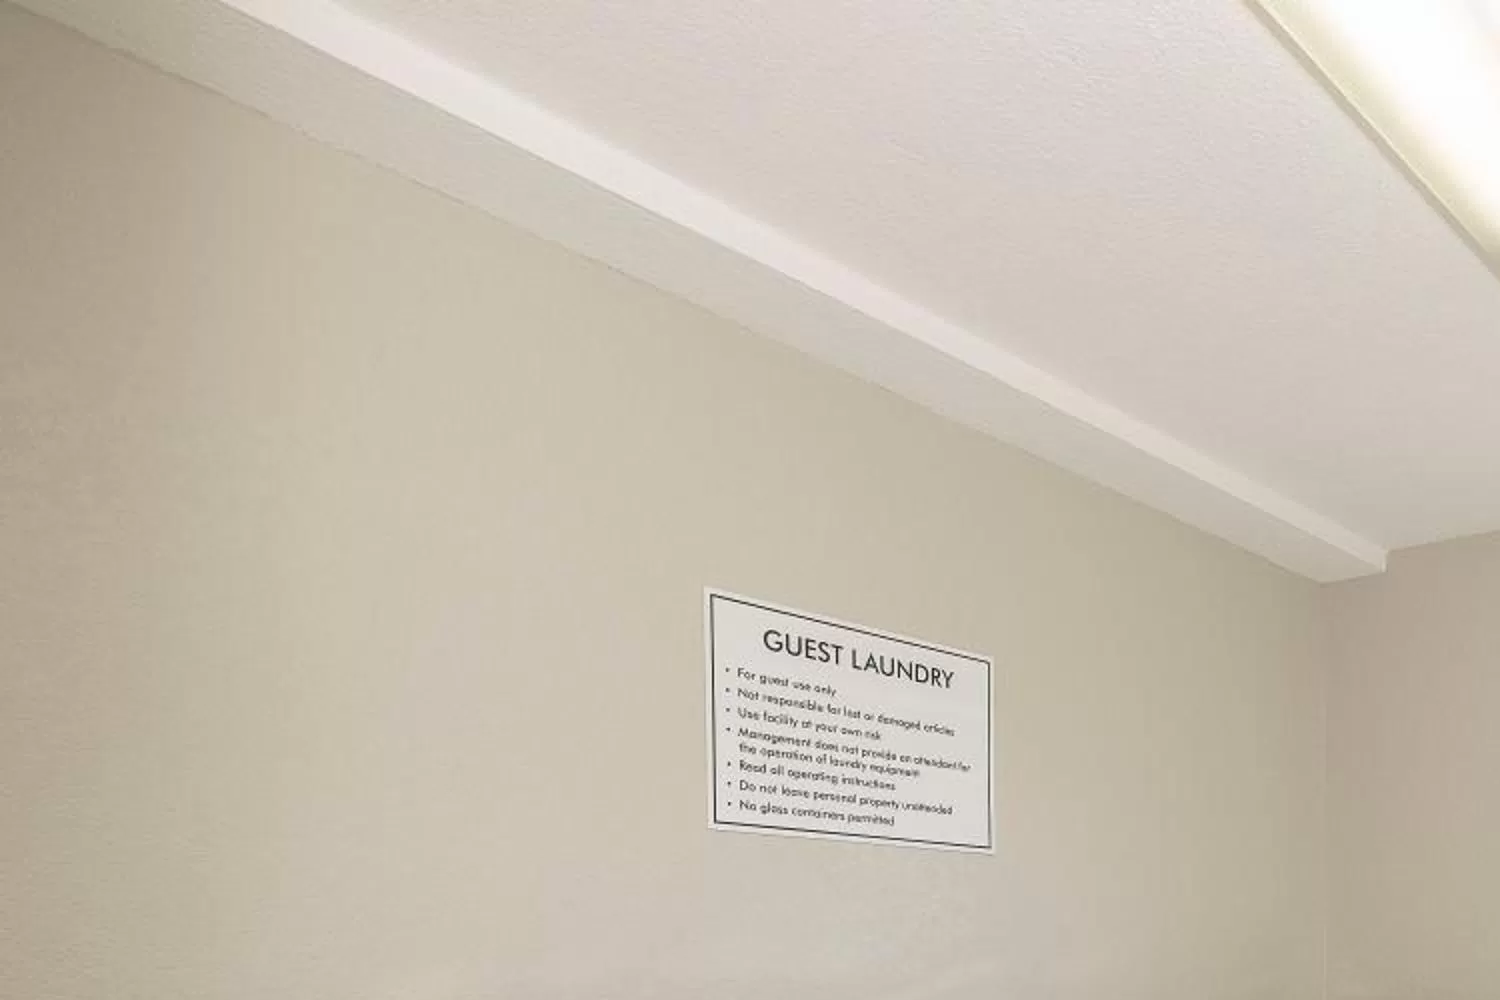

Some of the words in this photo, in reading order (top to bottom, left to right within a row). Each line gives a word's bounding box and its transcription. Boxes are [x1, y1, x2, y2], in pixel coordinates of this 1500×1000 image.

[763, 629, 844, 665] GUEST
[851, 649, 955, 689] LAUNDRY
[737, 667, 756, 681] For
[759, 675, 789, 687] guest
[791, 681, 811, 692] use
[813, 684, 837, 698] only
[737, 687, 760, 701] Not
[763, 694, 824, 713] responsible
[827, 703, 841, 716] for
[843, 706, 861, 719] lost
[863, 713, 875, 721] or
[877, 714, 921, 732] damaged
[737, 707, 760, 721] Use
[763, 710, 798, 728] facility
[801, 720, 812, 729] at
[815, 723, 838, 734] your
[840, 727, 862, 738] own
[864, 730, 882, 741] risk
[737, 727, 812, 748] Management
[814, 739, 839, 753] does
[841, 745, 859, 755] not
[861, 748, 897, 762] provide
[739, 742, 757, 755] the
[759, 748, 813, 763] operation
[815, 753, 827, 765] of
[829, 755, 867, 773] laundry
[739, 759, 767, 775] Read
[769, 764, 785, 777] all
[787, 769, 839, 786] operating
[739, 779, 757, 793] Do
[759, 784, 777, 796] not
[781, 784, 810, 799] leave
[813, 791, 857, 805] personal
[859, 797, 899, 811] property
[739, 799, 757, 812] No
[759, 801, 789, 816] glass
[791, 807, 845, 822] containers
[847, 813, 895, 828] permitted
